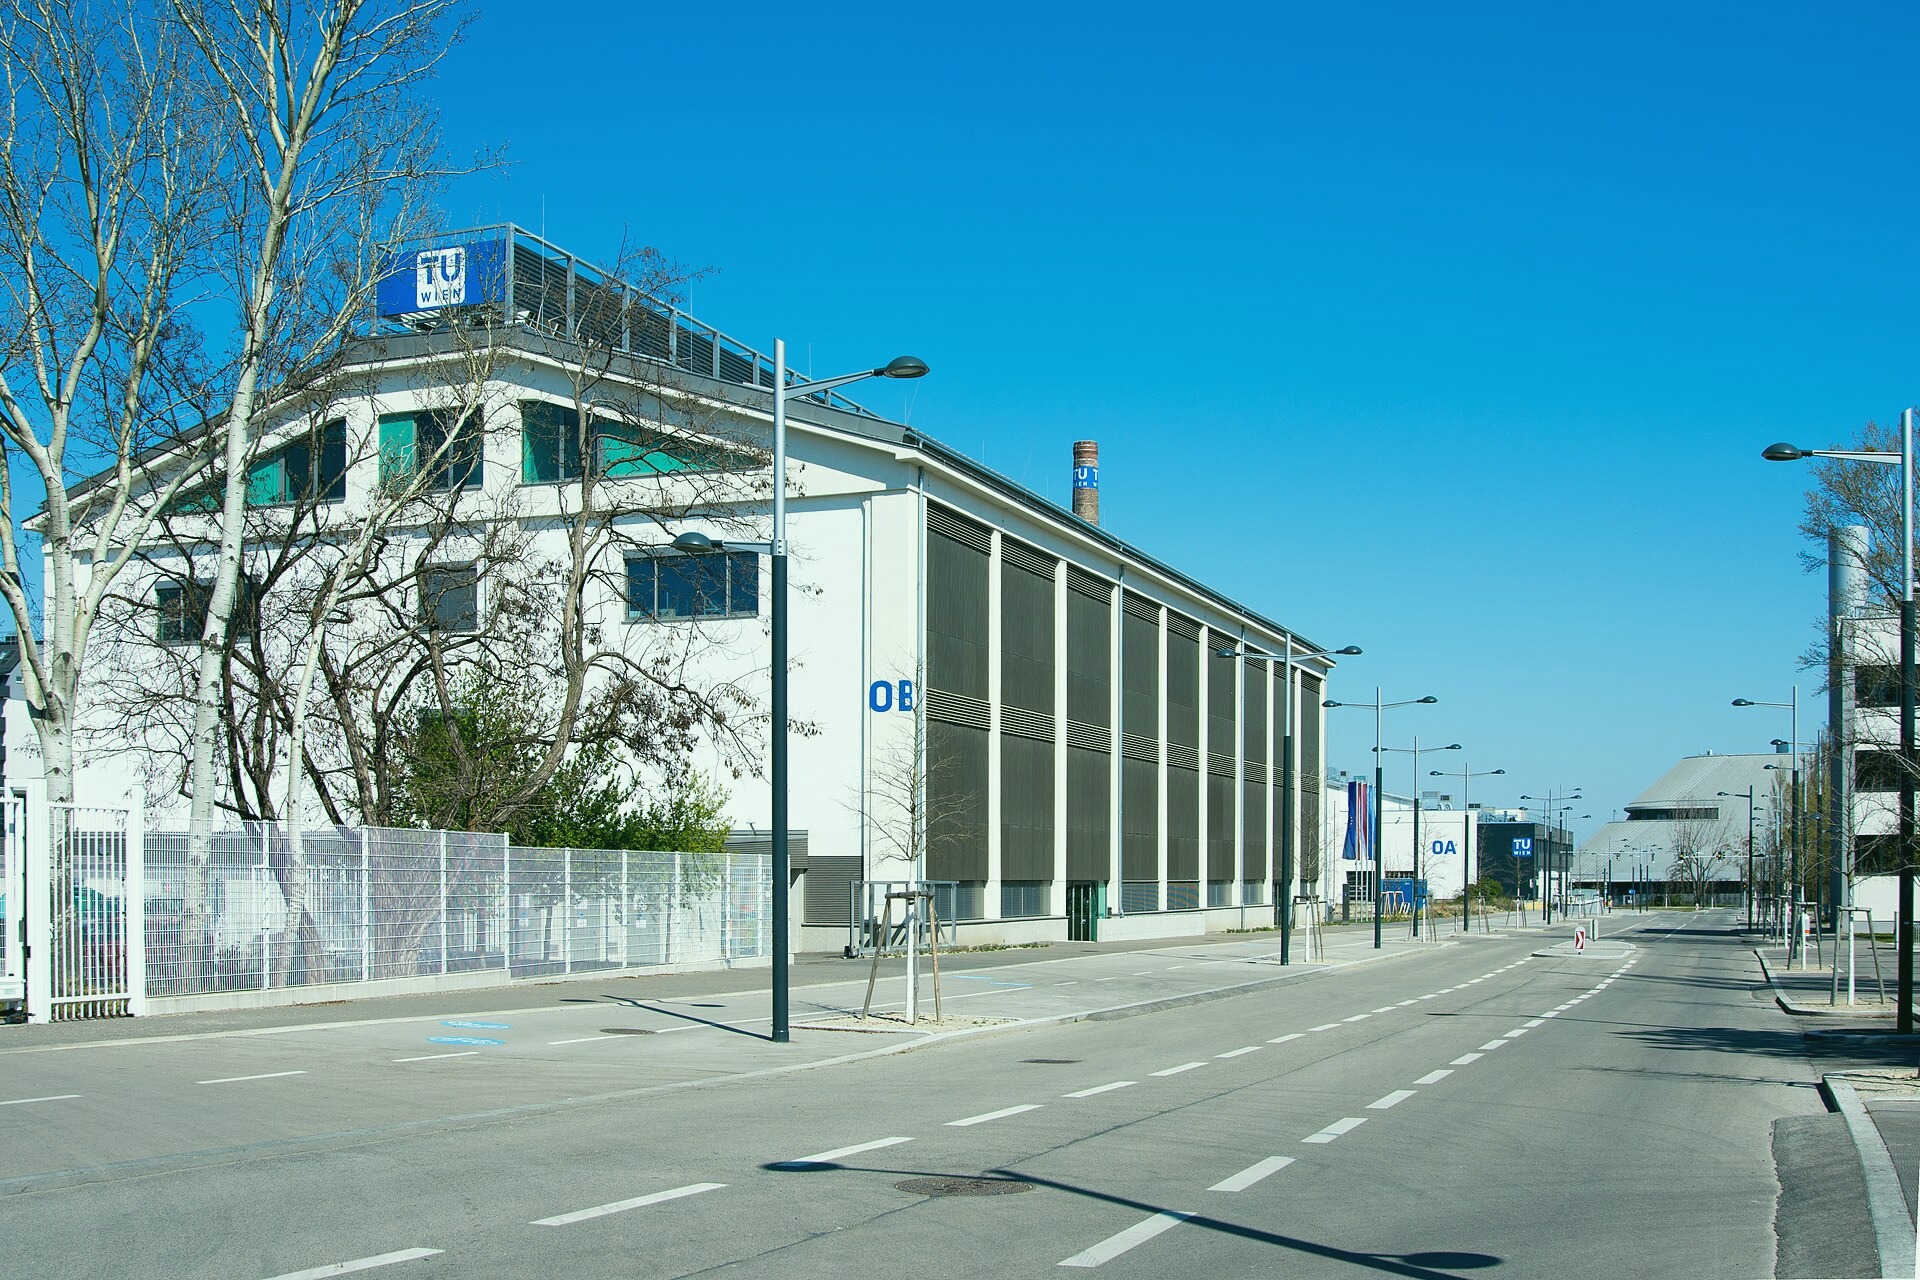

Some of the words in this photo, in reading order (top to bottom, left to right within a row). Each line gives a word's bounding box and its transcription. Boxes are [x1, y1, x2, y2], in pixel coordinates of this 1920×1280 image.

[420, 253, 461, 285] TU
[421, 287, 461, 303] WIEN
[869, 680, 913, 712] OB
[1432, 840, 1457, 855] OA
[1513, 838, 1531, 850] TU
